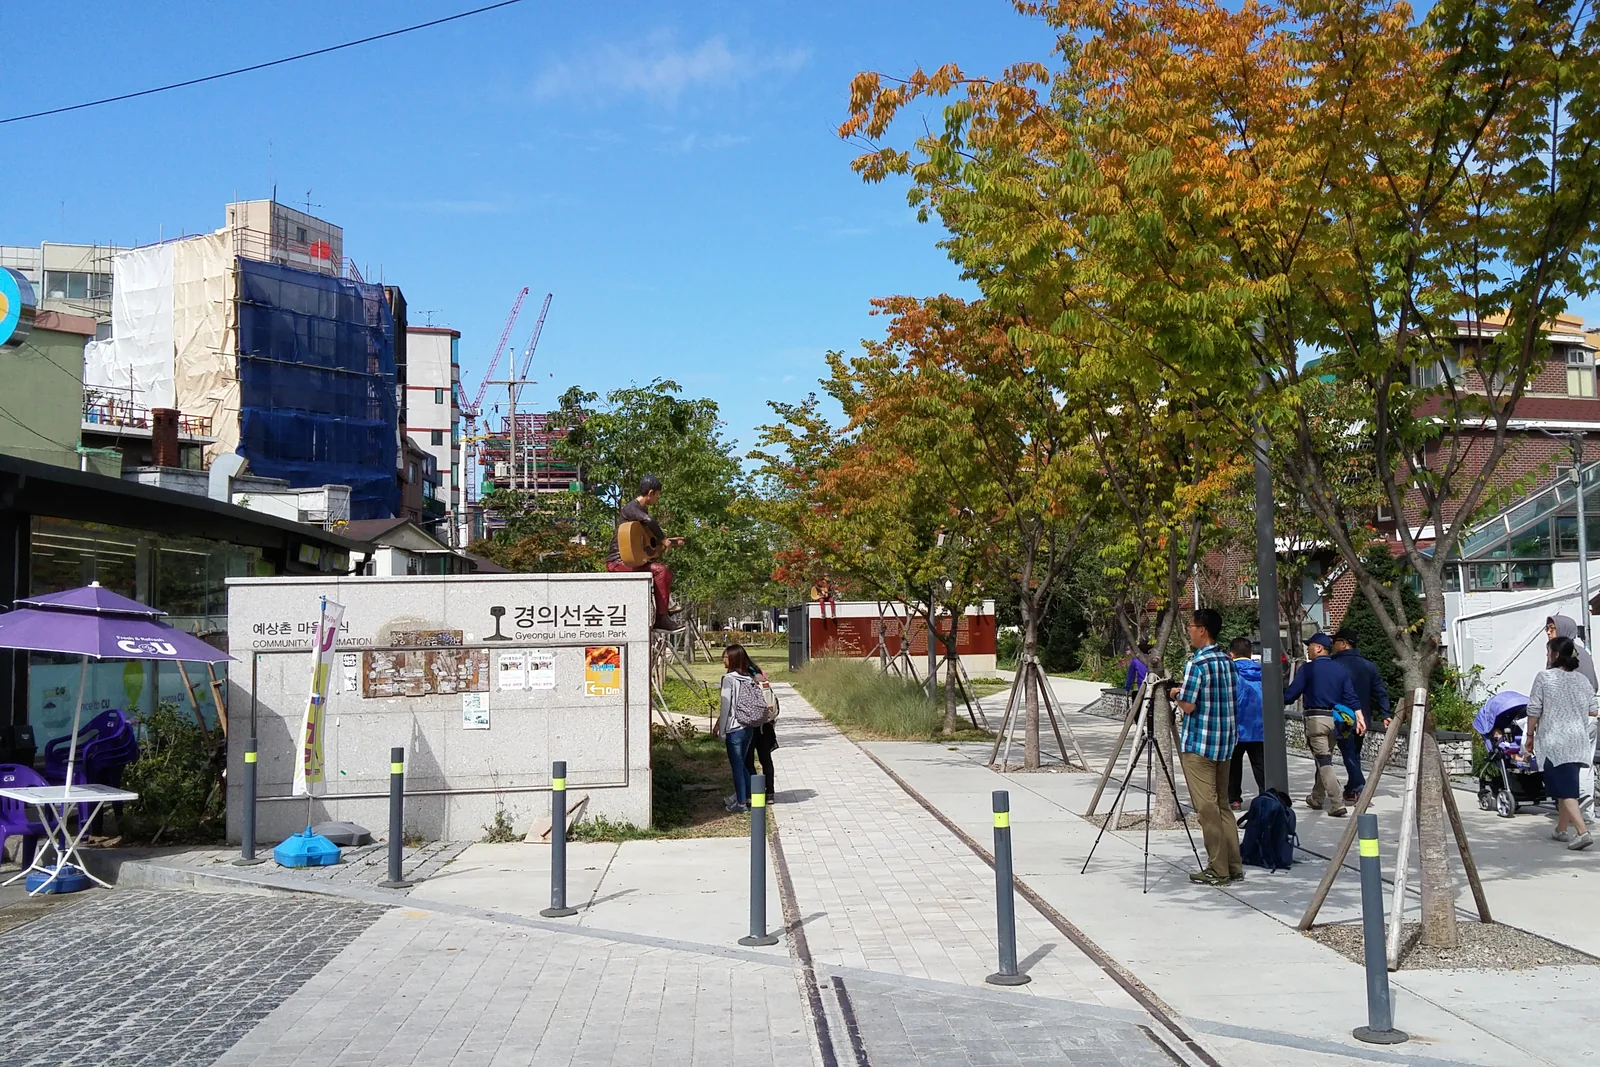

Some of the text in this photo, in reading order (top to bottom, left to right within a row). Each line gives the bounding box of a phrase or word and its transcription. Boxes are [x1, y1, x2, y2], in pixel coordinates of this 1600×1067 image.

[514, 604, 627, 629] 경의선숲길
[252, 622, 292, 635] 예상촌
[515, 629, 627, 641] Gyeongui Line Forest Park
[252, 640, 309, 648] COMMUNITY
